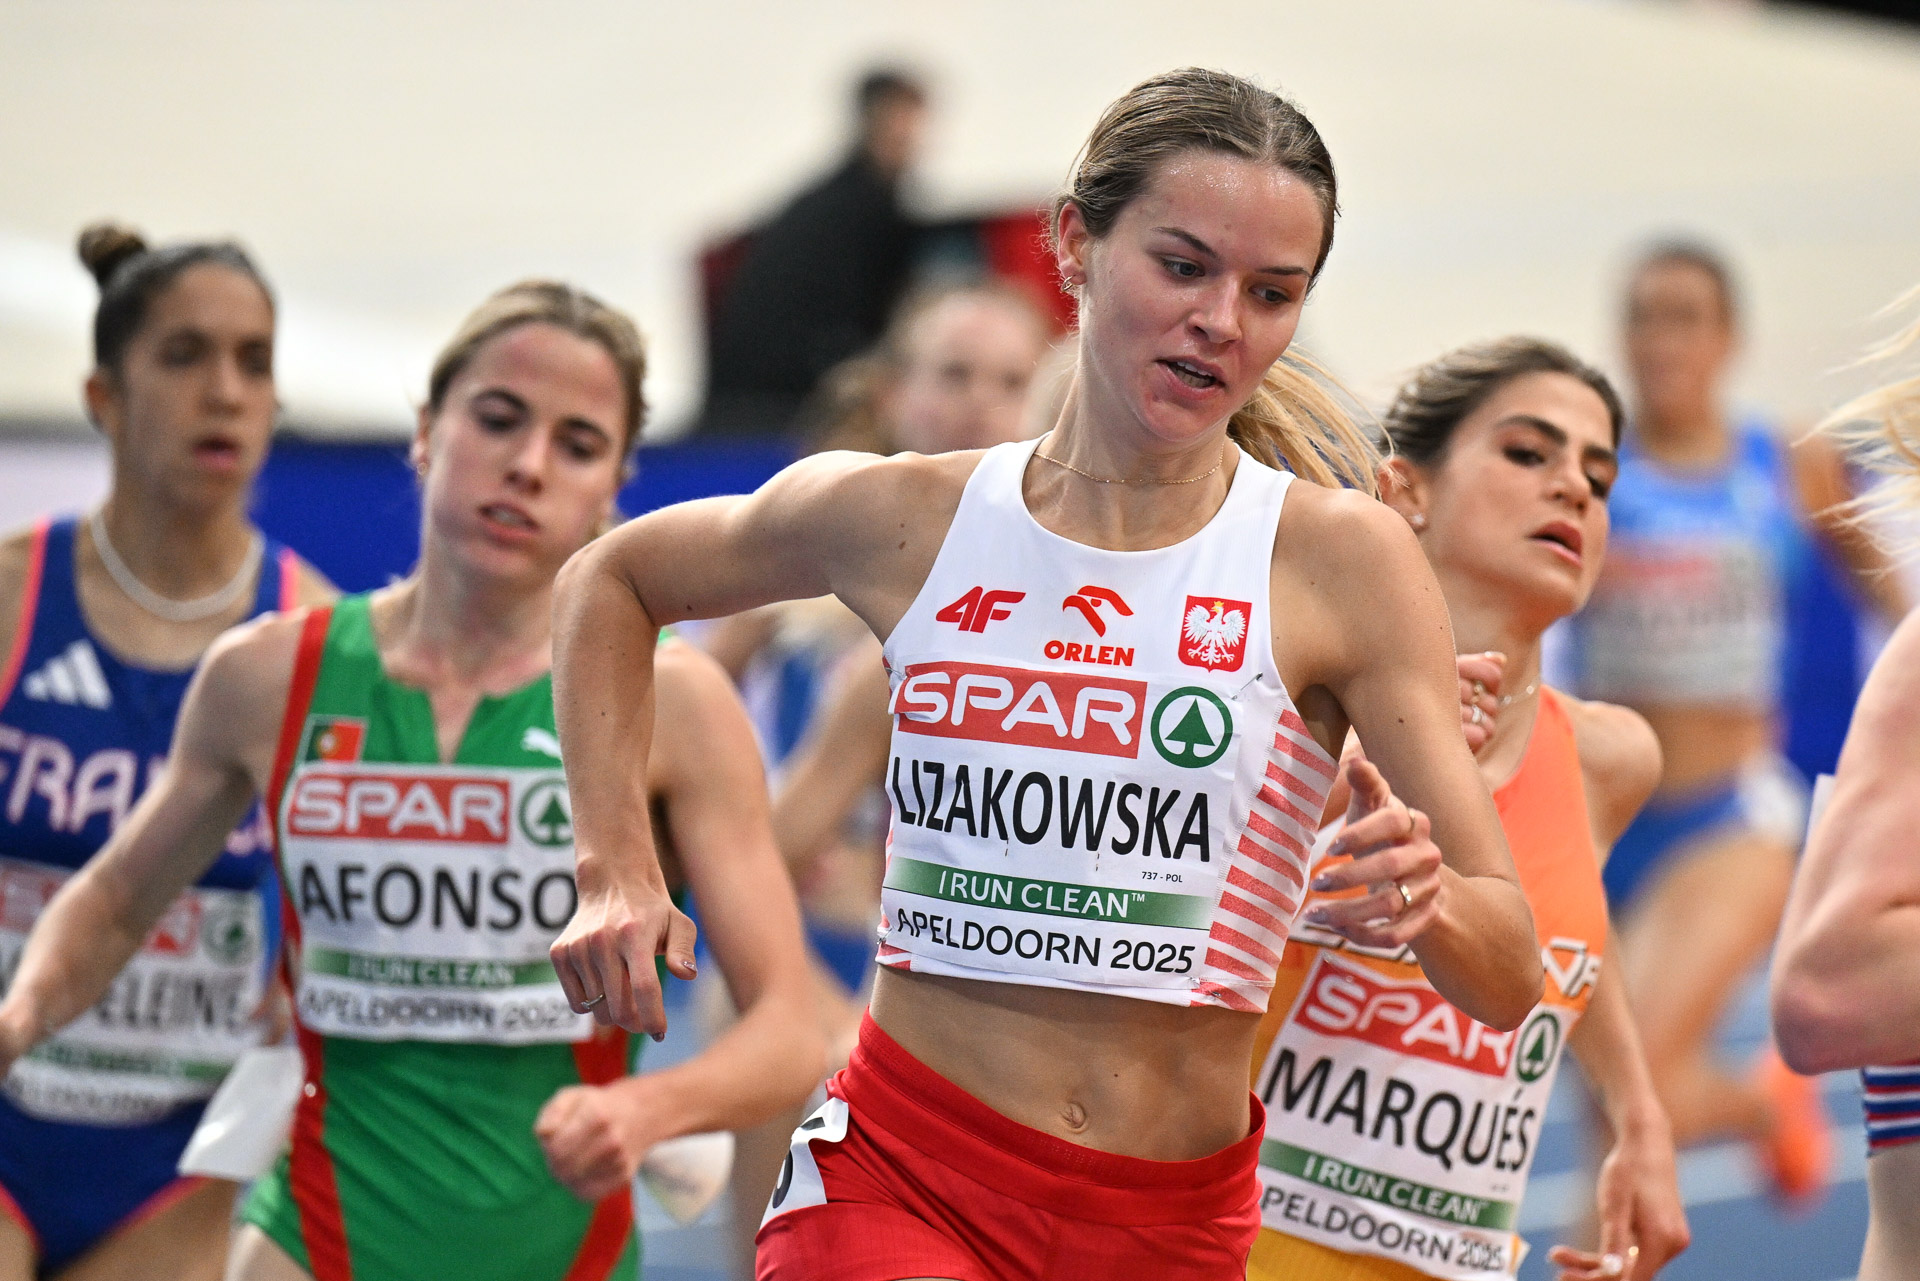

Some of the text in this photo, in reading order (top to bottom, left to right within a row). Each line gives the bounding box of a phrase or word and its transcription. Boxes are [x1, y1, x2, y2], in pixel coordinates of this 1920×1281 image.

[935, 585, 1027, 634] 4F
[1044, 640, 1135, 667] ORLEN
[903, 671, 1137, 747] SPAR
[292, 779, 506, 838] SPAR
[891, 756, 1210, 863] LIZAKOWSKA
[302, 860, 579, 932] AFONSO
[939, 870, 947, 894] I
[953, 874, 1013, 905] RUN
[1142, 871, 1158, 880] 737
[1165, 873, 1183, 883] POL
[897, 907, 1196, 974] APELDOORN 2025
[1306, 974, 1513, 1068] SPAR
[1263, 1048, 1537, 1172] MARQUÉS
[1302, 1155, 1317, 1178] I
[1318, 1160, 1387, 1201] RUN
[1260, 1185, 1506, 1273] PELDOORN 2025
